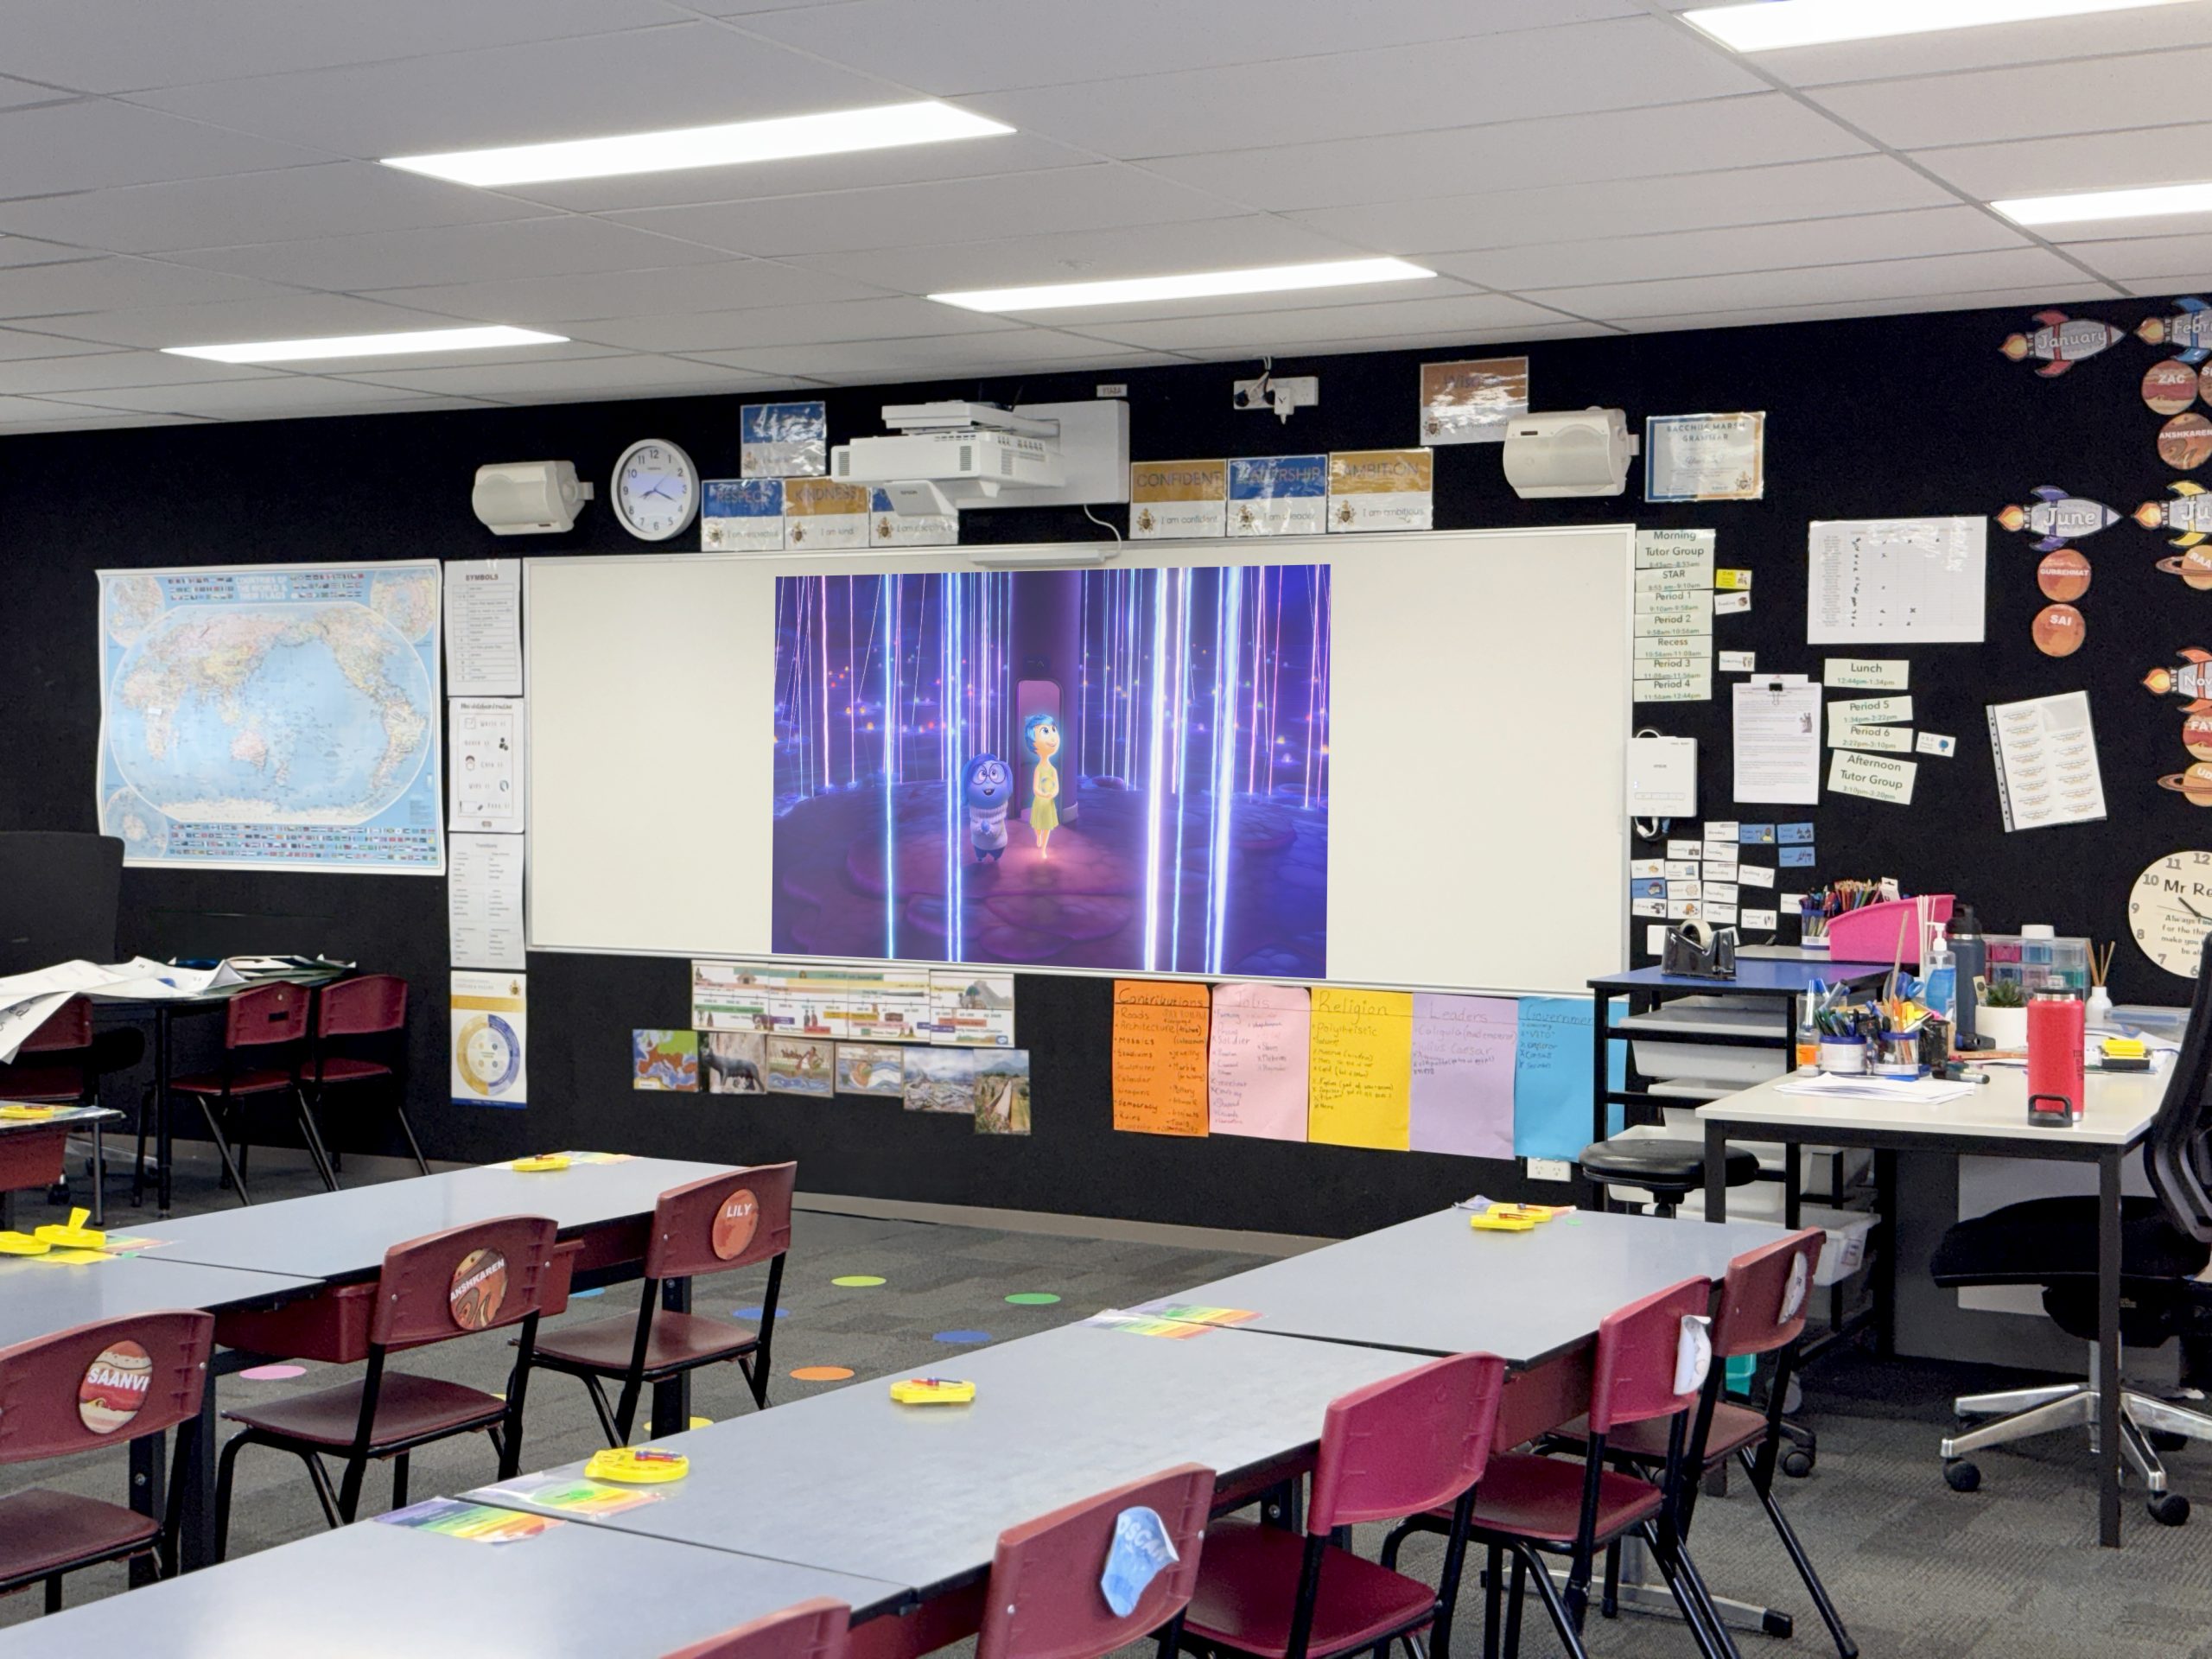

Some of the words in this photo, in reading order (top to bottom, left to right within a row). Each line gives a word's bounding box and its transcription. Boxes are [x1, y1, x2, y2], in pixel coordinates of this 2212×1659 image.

[2037, 330, 2108, 350] January
[2158, 373, 2186, 385] ZAC
[638, 455, 645, 465] 11
[650, 449, 660, 460] 12
[667, 454, 672, 464] 1
[627, 468, 638, 479] 10
[677, 467, 683, 477] 2
[1136, 470, 1223, 488] CONFIDENT
[622, 486, 629, 495] 9
[682, 485, 688, 494] 3
[795, 485, 858, 501] KINDNESS
[628, 505, 635, 515] 8
[677, 505, 683, 513] 4
[639, 517, 645, 526] 7
[668, 517, 674, 526] 5
[2043, 507, 2096, 526] June
[653, 521, 660, 531] 6
[1653, 531, 1697, 542] Morning
[1645, 547, 1669, 556] Tutor
[1672, 546, 1705, 557] Group
[1662, 570, 1686, 579] STAR
[1656, 592, 1684, 601] Period
[1655, 615, 1683, 625] Period
[1686, 614, 1692, 623] 2
[2050, 614, 2073, 626] SAI
[1654, 659, 1682, 668] Period
[1685, 658, 1691, 667] 3
[1851, 663, 1883, 673] Lunch
[1654, 680, 1682, 689] Period
[1684, 679, 1691, 688] 4
[1849, 701, 1881, 712] Period
[1883, 700, 1890, 709] 5
[1850, 725, 1882, 737] Period
[1883, 728, 1891, 737] 6
[1847, 754, 1902, 772] Afternoon
[1840, 769, 1866, 782] Tutor
[1869, 773, 1904, 791] Group
[2165, 857, 2182, 871] 11
[2193, 852, 2211, 865] 12
[2143, 874, 2159, 887] 10
[2164, 879, 2186, 894] Mr
[2131, 902, 2140, 914] 9
[2136, 929, 2145, 940] 8
[2158, 953, 2167, 965] 7
[2190, 965, 2199, 976] 6
[1118, 987, 1204, 1007] Contributions
[1121, 1007, 1149, 1020] Roads
[1319, 990, 1389, 1025] Religion
[1430, 1001, 1489, 1024] Leaders
[1121, 1020, 1175, 1033] Architecture
[726, 1203, 753, 1218] LILY
[450, 1257, 505, 1303] ANSHKAREN
[87, 1367, 150, 1392] SAANVI
